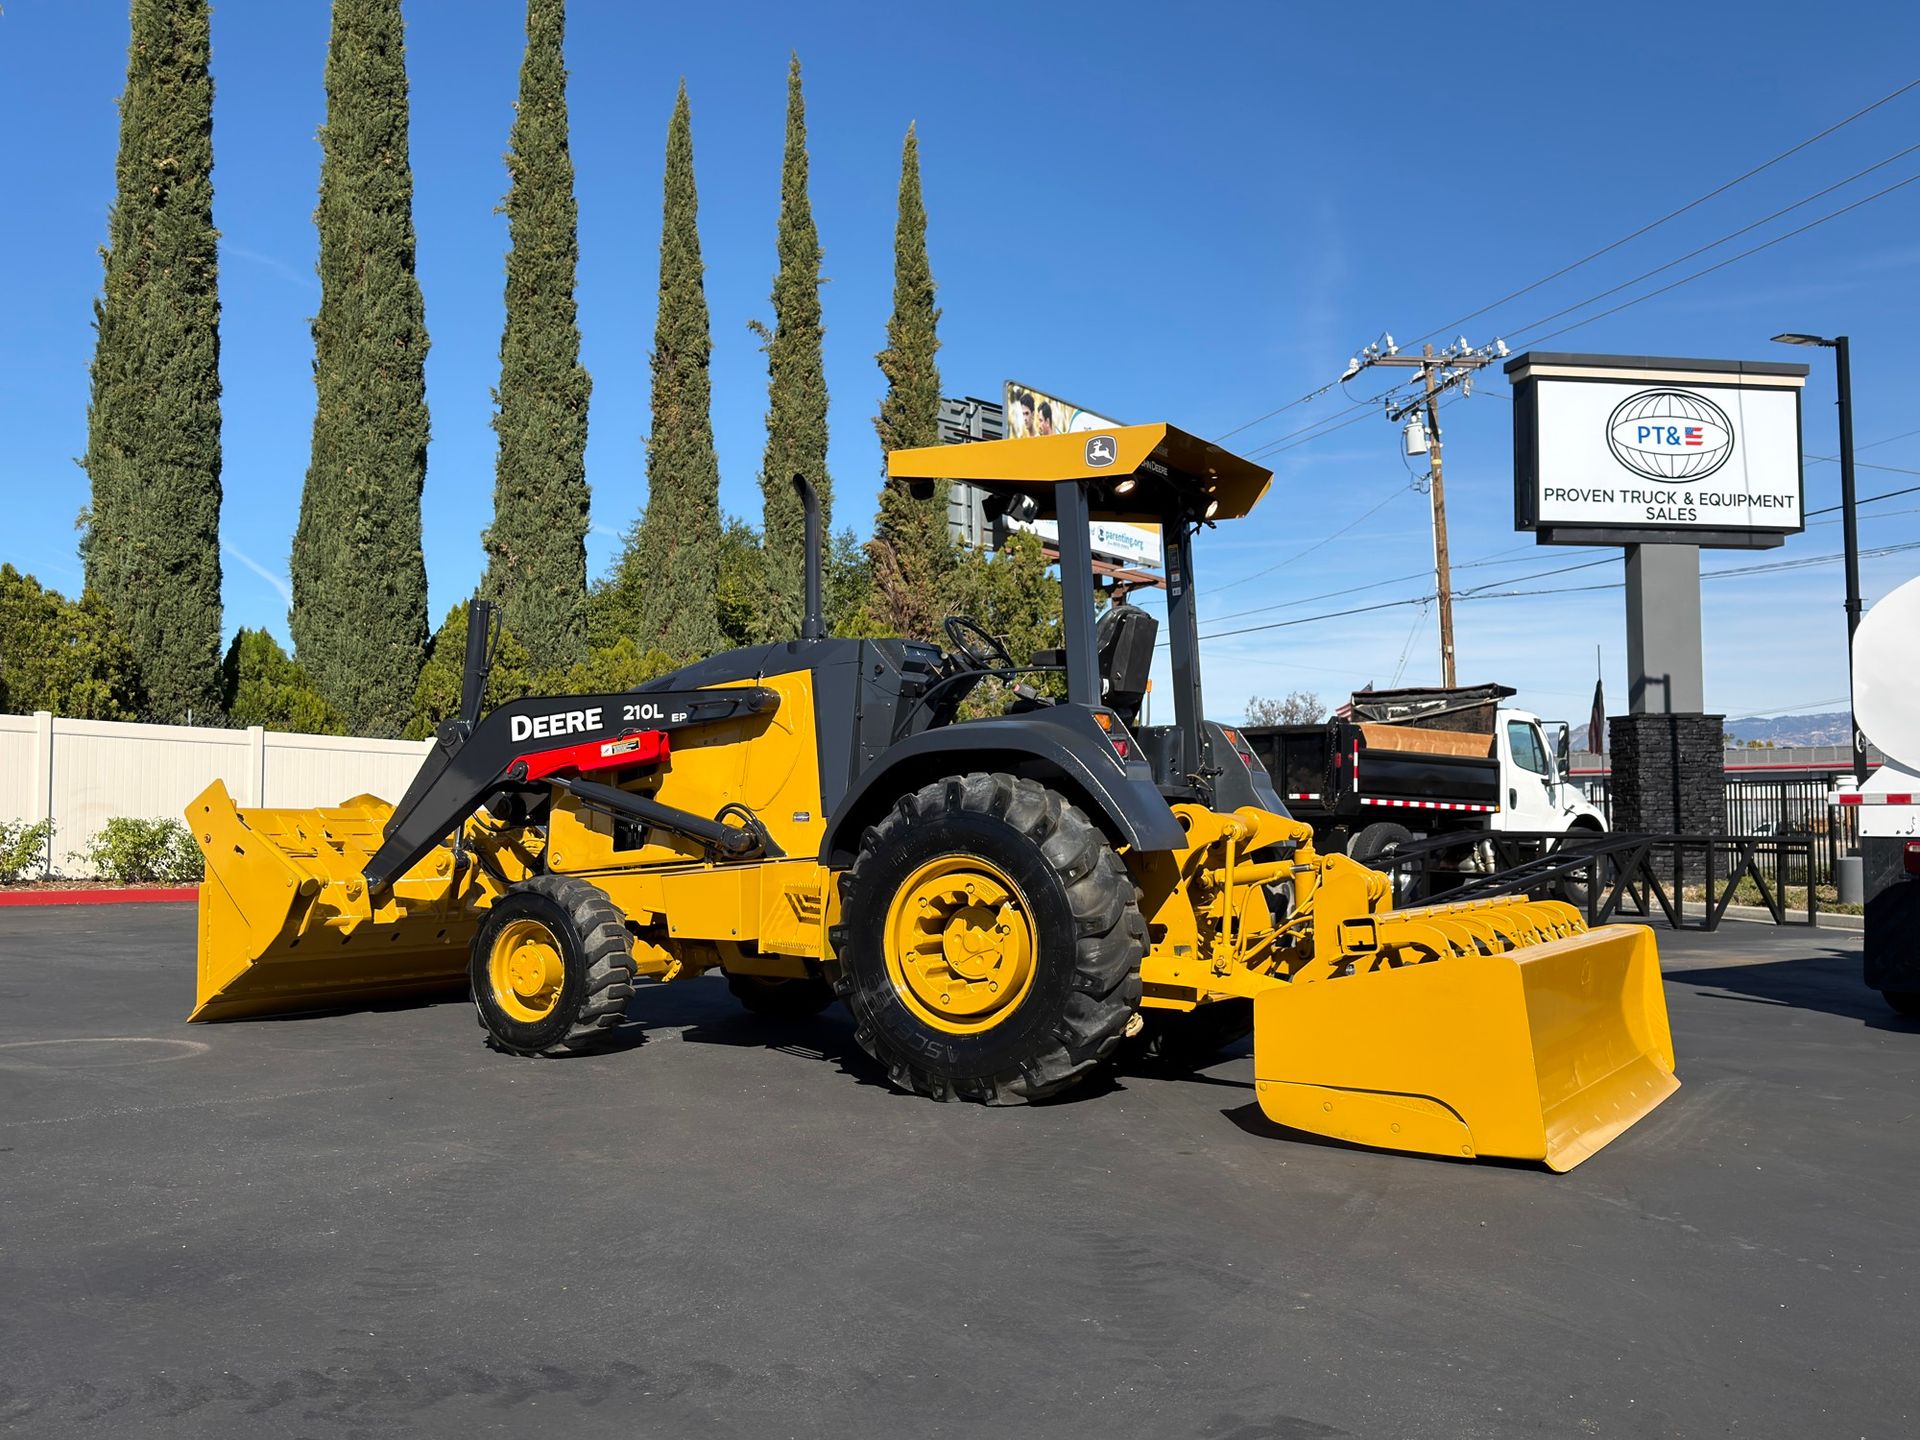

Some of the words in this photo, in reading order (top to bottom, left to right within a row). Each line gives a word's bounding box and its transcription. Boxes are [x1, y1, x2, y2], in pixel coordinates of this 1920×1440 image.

[1544, 488, 1615, 503] PROVEN
[1620, 490, 1676, 505] TRUCK
[1684, 492, 1694, 505] &
[1700, 493, 1794, 508] EQUIPMENT
[1645, 507, 1697, 521] SALES
[623, 704, 664, 721] 210L
[671, 712, 688, 722] EP
[511, 708, 603, 742] DEERE
